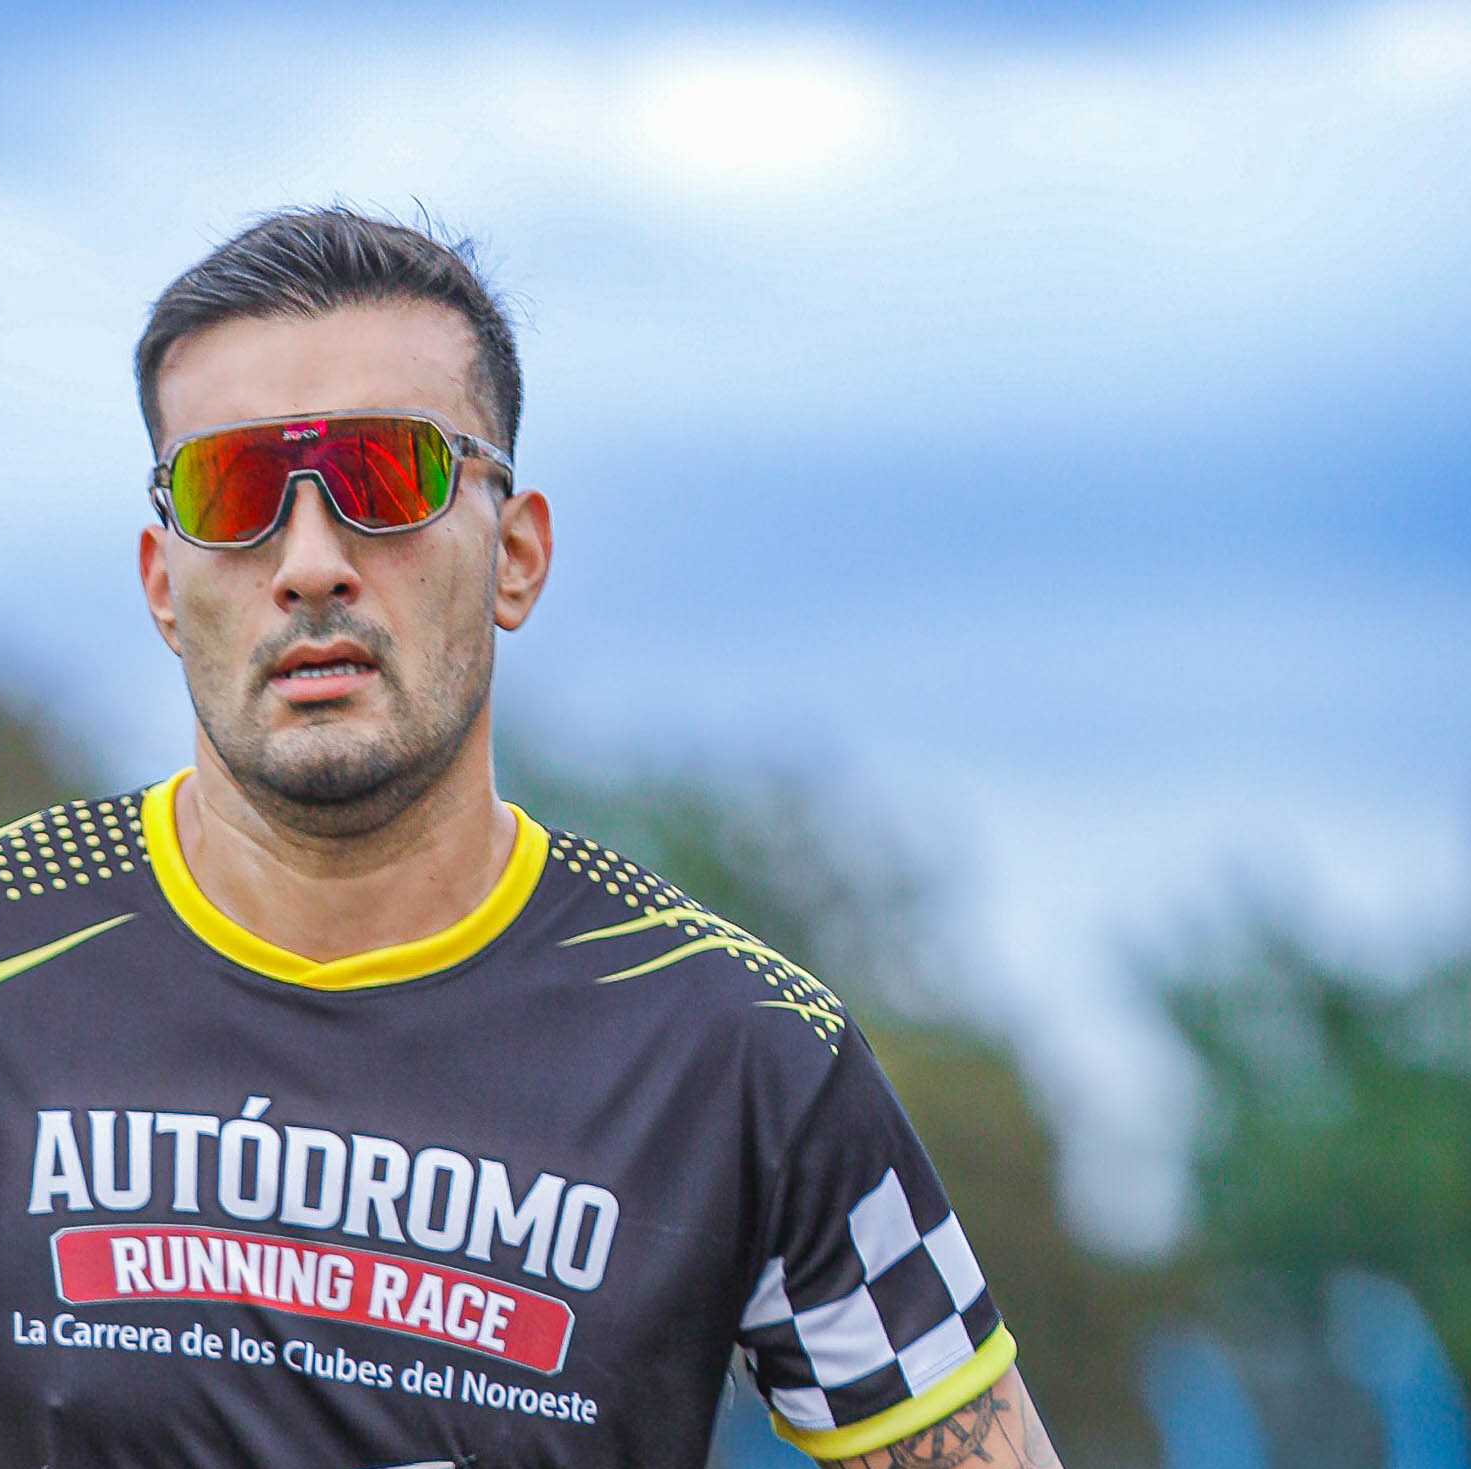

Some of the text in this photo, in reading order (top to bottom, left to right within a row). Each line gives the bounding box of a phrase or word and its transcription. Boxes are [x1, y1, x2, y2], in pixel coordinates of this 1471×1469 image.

[27, 1094, 620, 1291] AUTÓDROMO
[110, 1235, 517, 1353] RUNNING RACE
[12, 1310, 600, 1425] La Carrera de los Clubes del Noroeste
